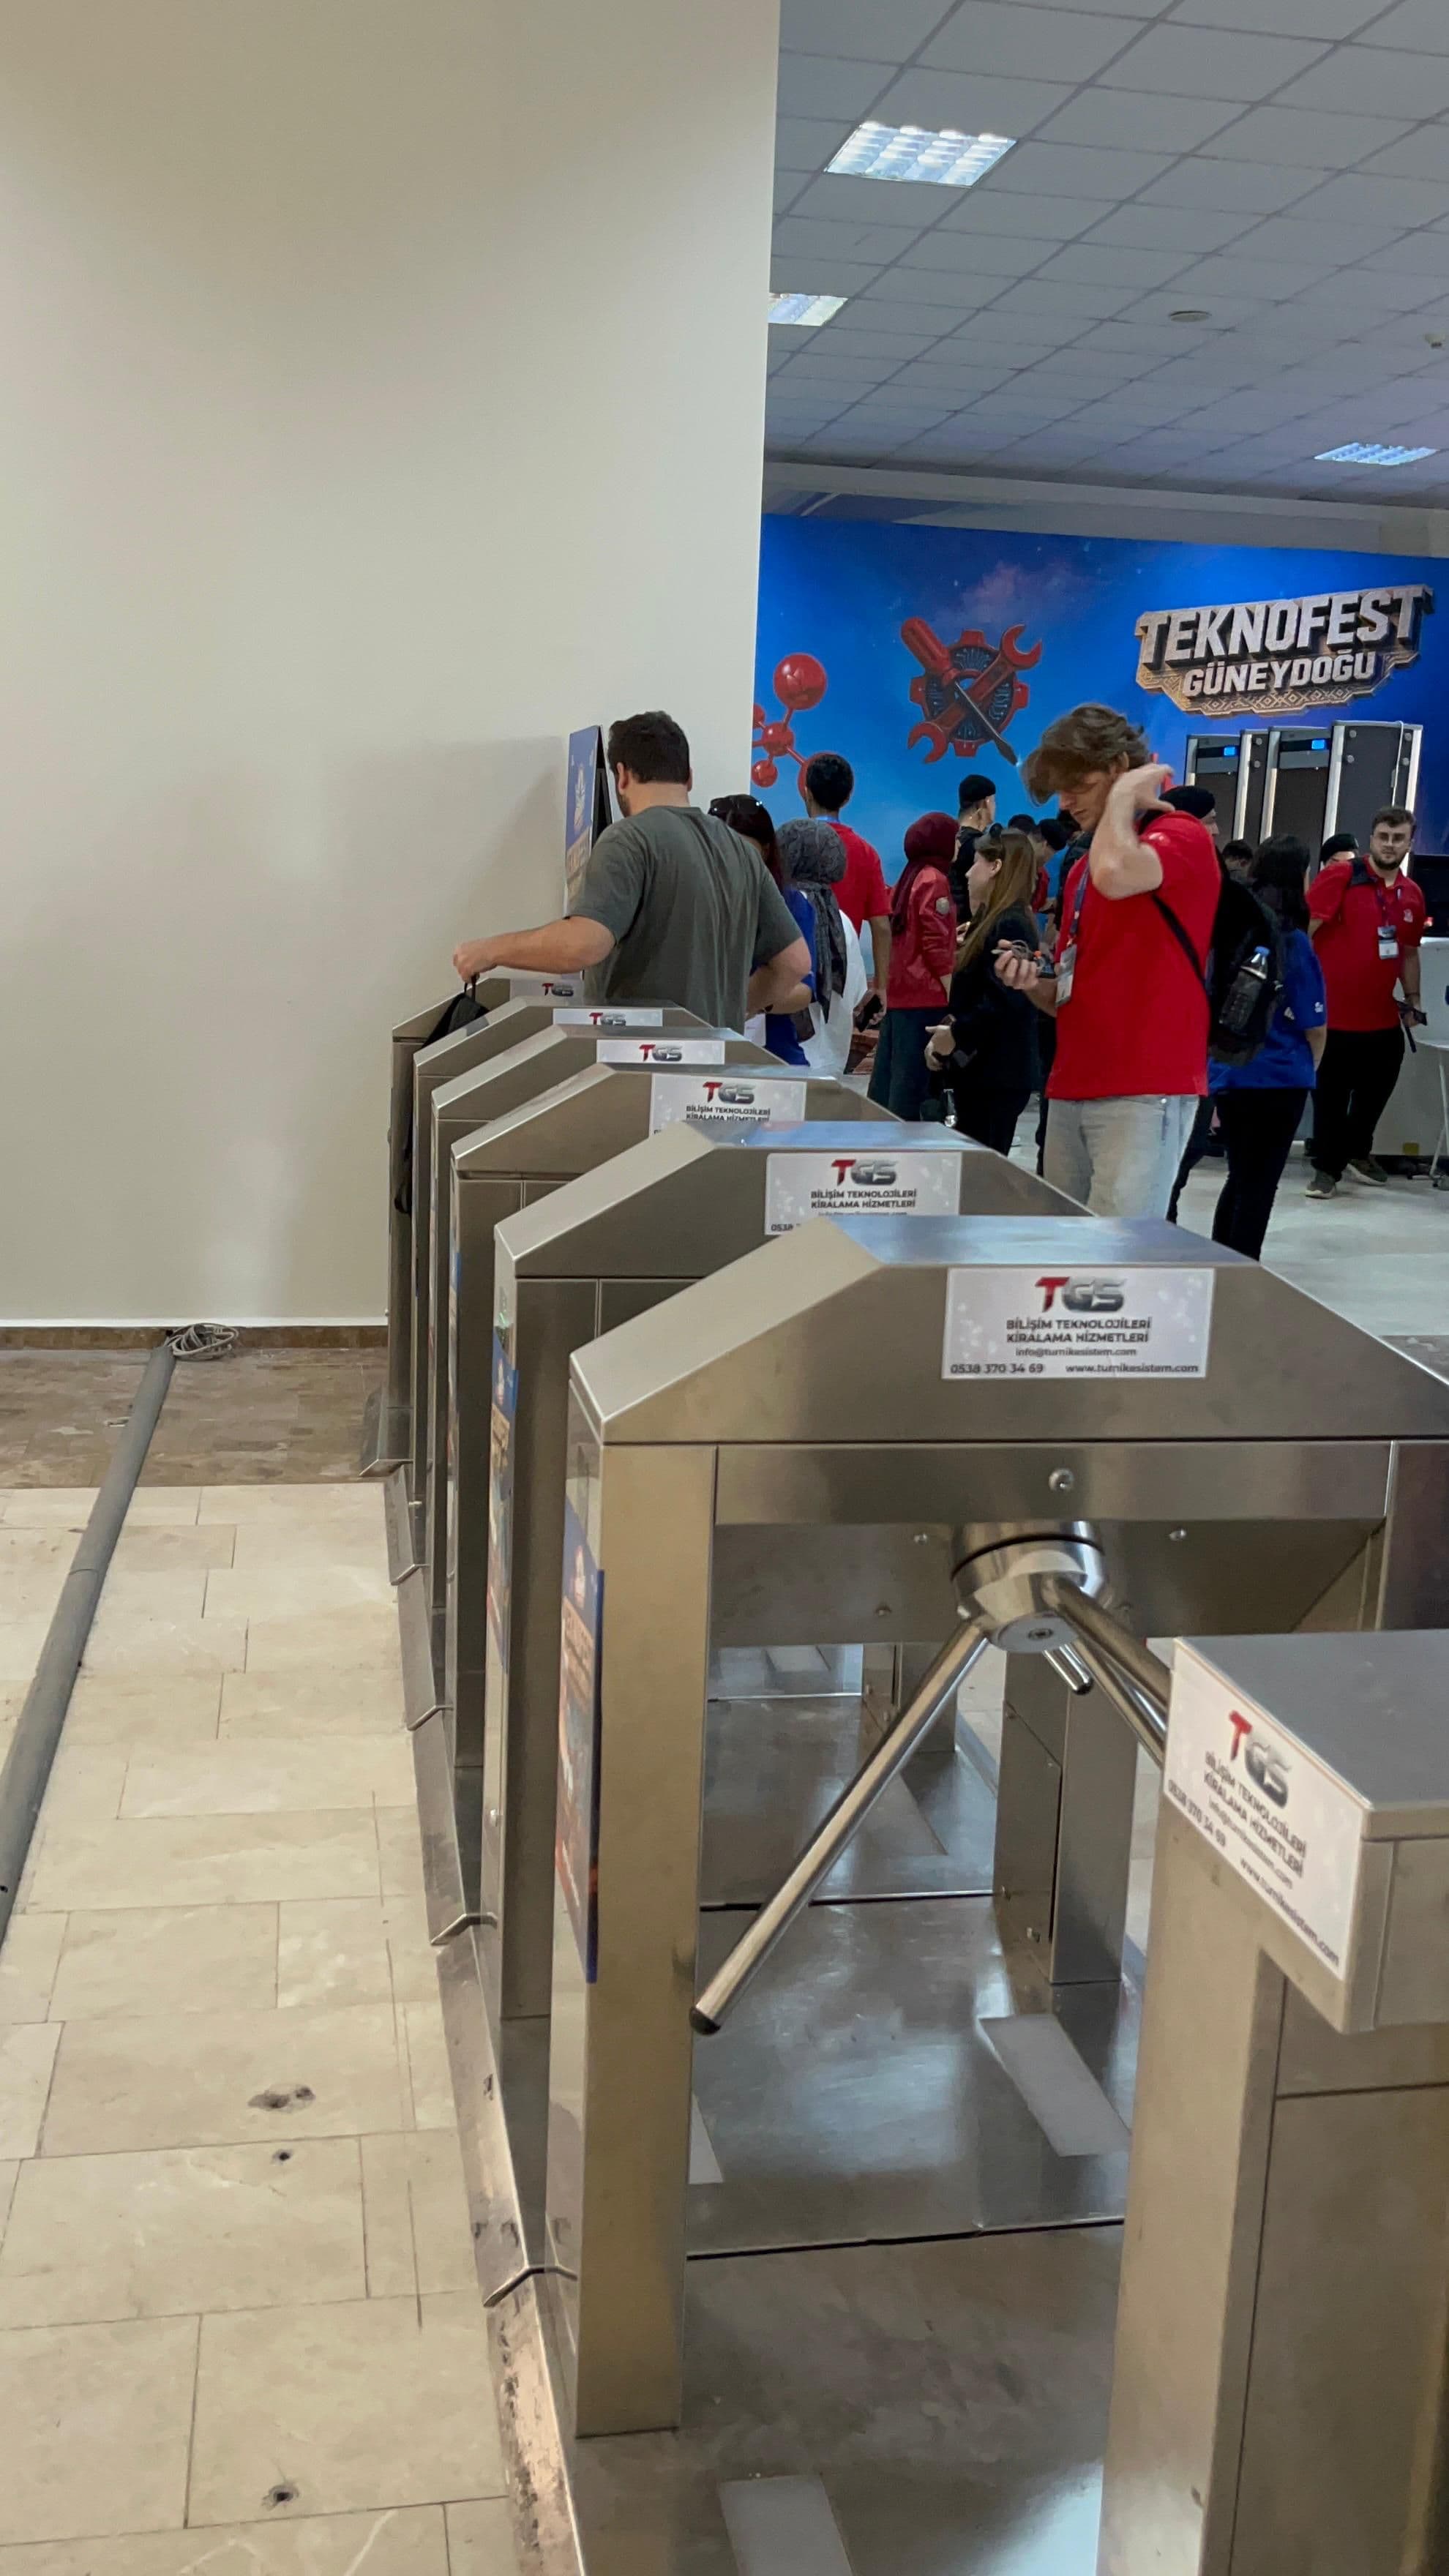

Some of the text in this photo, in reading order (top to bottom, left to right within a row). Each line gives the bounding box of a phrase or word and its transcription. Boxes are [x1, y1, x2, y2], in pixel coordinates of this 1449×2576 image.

[1137, 586, 1429, 665] TEKNOFEST
[1182, 649, 1376, 697] GÜNEYDOĞU
[639, 1044, 683, 1061] TGS
[703, 1082, 755, 1104] TGS
[686, 1104, 771, 1116] BİLİŞİM TEKNOLOJİLERİ
[831, 1159, 898, 1186] TGS
[811, 1188, 917, 1200] BİLİŞİM TEKNOLOJİLERİ
[811, 1199, 916, 1208] KİRALAMA HİZMETLERİ
[1035, 1276, 1127, 1312] TGS
[1006, 1317, 1150, 1330] BİLİŞİM TEKNOLOJİLERİ
[1007, 1330, 1148, 1342] KİRALAMA HİZMETLERİ
[951, 1361, 1199, 1374] 0538 370 34 69 www.turnikesistem.com
[1229, 1709, 1292, 1810] TGS
